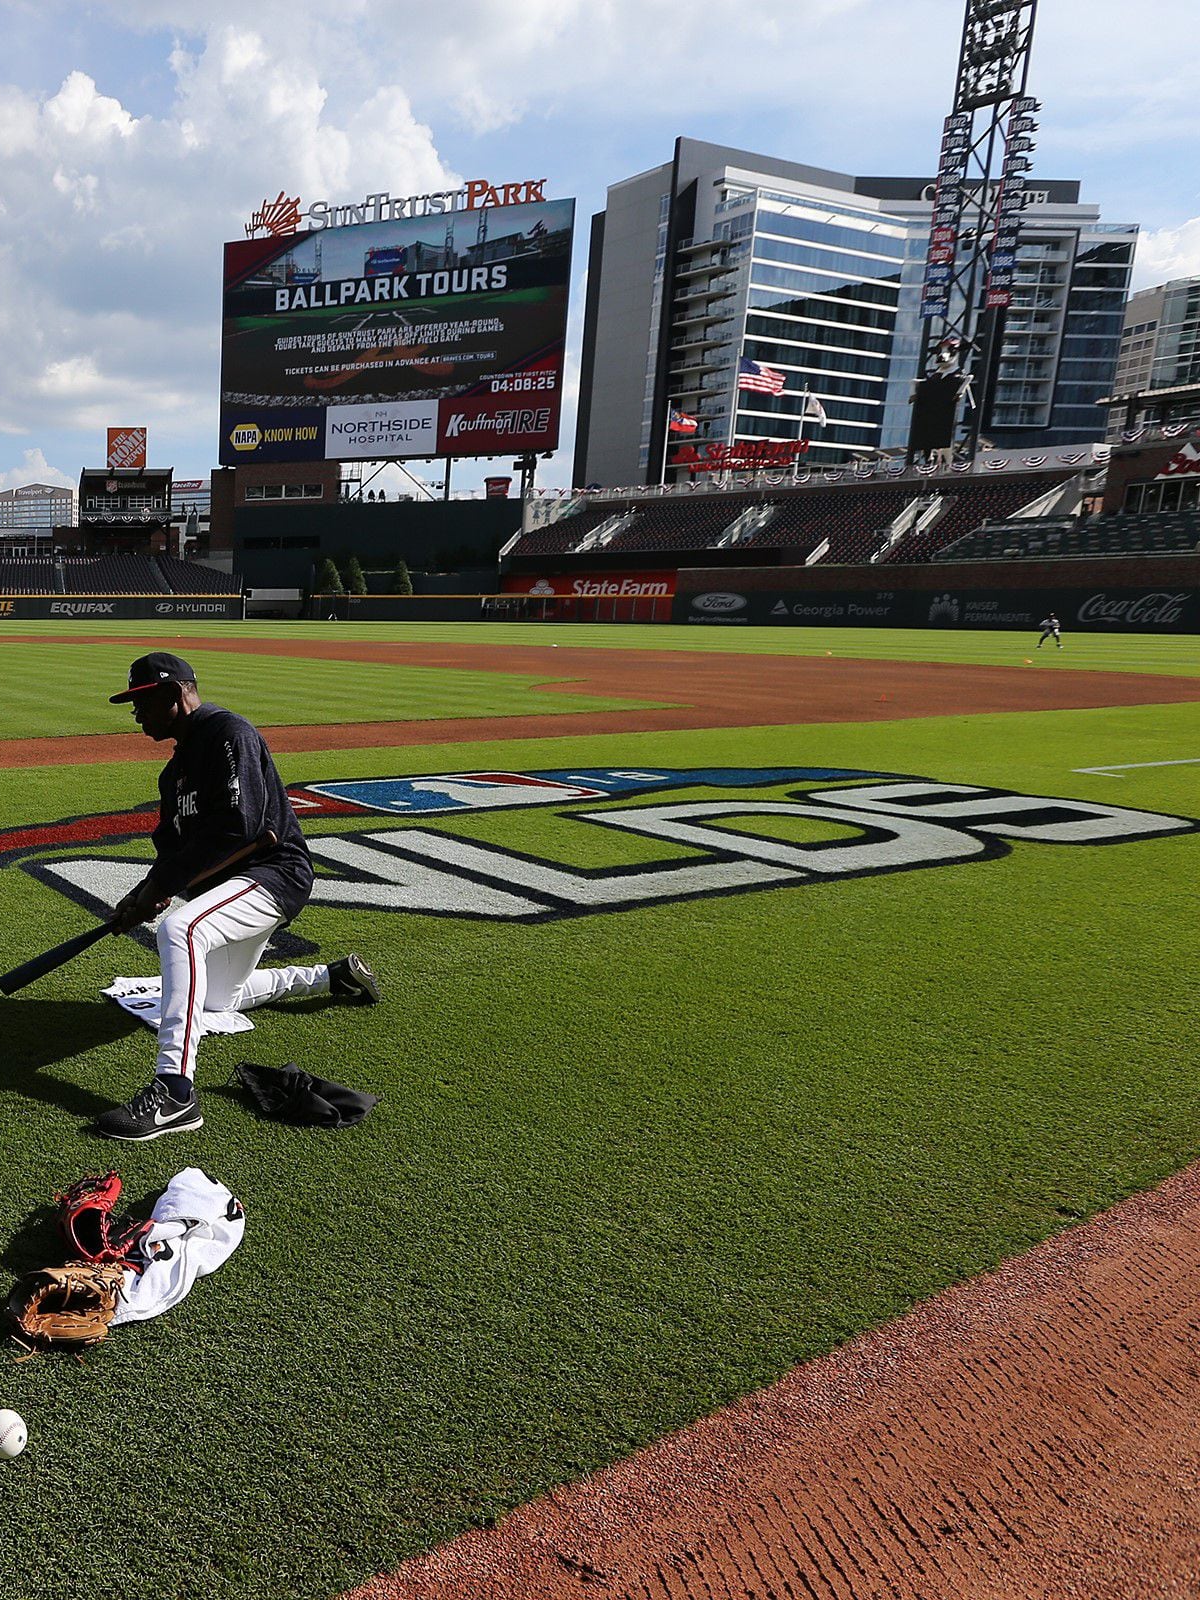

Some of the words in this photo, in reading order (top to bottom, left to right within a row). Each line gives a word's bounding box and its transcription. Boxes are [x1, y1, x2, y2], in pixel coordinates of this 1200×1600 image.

[1013, 120, 1031, 129] 1875
[275, 275, 410, 312] BALLPARK
[416, 264, 508, 297] TOURS
[275, 342, 296, 351] TOURS
[299, 340, 315, 349] TAKE
[318, 338, 343, 347] GUESTS
[356, 335, 377, 344] MANY
[379, 333, 403, 342] AREAS
[420, 329, 445, 338] LIMITS
[447, 327, 475, 336] DURING
[477, 324, 504, 333] GAMES
[277, 336, 301, 345] GUIDED
[303, 334, 326, 342] TOURS
[338, 329, 375, 339] SUNTRUST
[377, 327, 396, 335] PARK
[415, 323, 448, 331] OFFERED
[328, 344, 355, 353] DEPART
[357, 341, 377, 350] FROM
[378, 340, 392, 348] THE
[393, 339, 415, 347] RIGHT
[418, 336, 439, 344] FIELD
[440, 334, 461, 342] GATE.
[286, 367, 313, 375] TICKETS
[314, 365, 329, 373] CAN
[341, 361, 383, 371] PURCHASED
[395, 357, 429, 367] ADVANCE
[430, 356, 440, 364] AT
[491, 376, 555, 393] 04:08:25
[331, 418, 432, 434] NORTHSIDE
[445, 412, 512, 437] Kauffman
[495, 408, 551, 435] TIRE
[111, 432, 128, 448] THE
[234, 431, 258, 444] NAPA
[264, 428, 292, 443] KNOW
[295, 426, 318, 440] HOW
[348, 433, 413, 444] HOSPITAL
[108, 428, 146, 467] HOME
[122, 442, 145, 467] DEPOT
[17, 488, 42, 496] Travelport
[50, 603, 114, 616] EQUIFAX
[176, 604, 226, 612] HYUNDAI
[702, 596, 737, 609] Ford
[793, 603, 844, 617] Georgia
[847, 604, 890, 615] Power
[965, 601, 998, 610] KAISER
[1077, 593, 1193, 623] Coca-Cola
[964, 612, 1032, 623] PERMANENTE
[566, 770, 669, 786] 18
